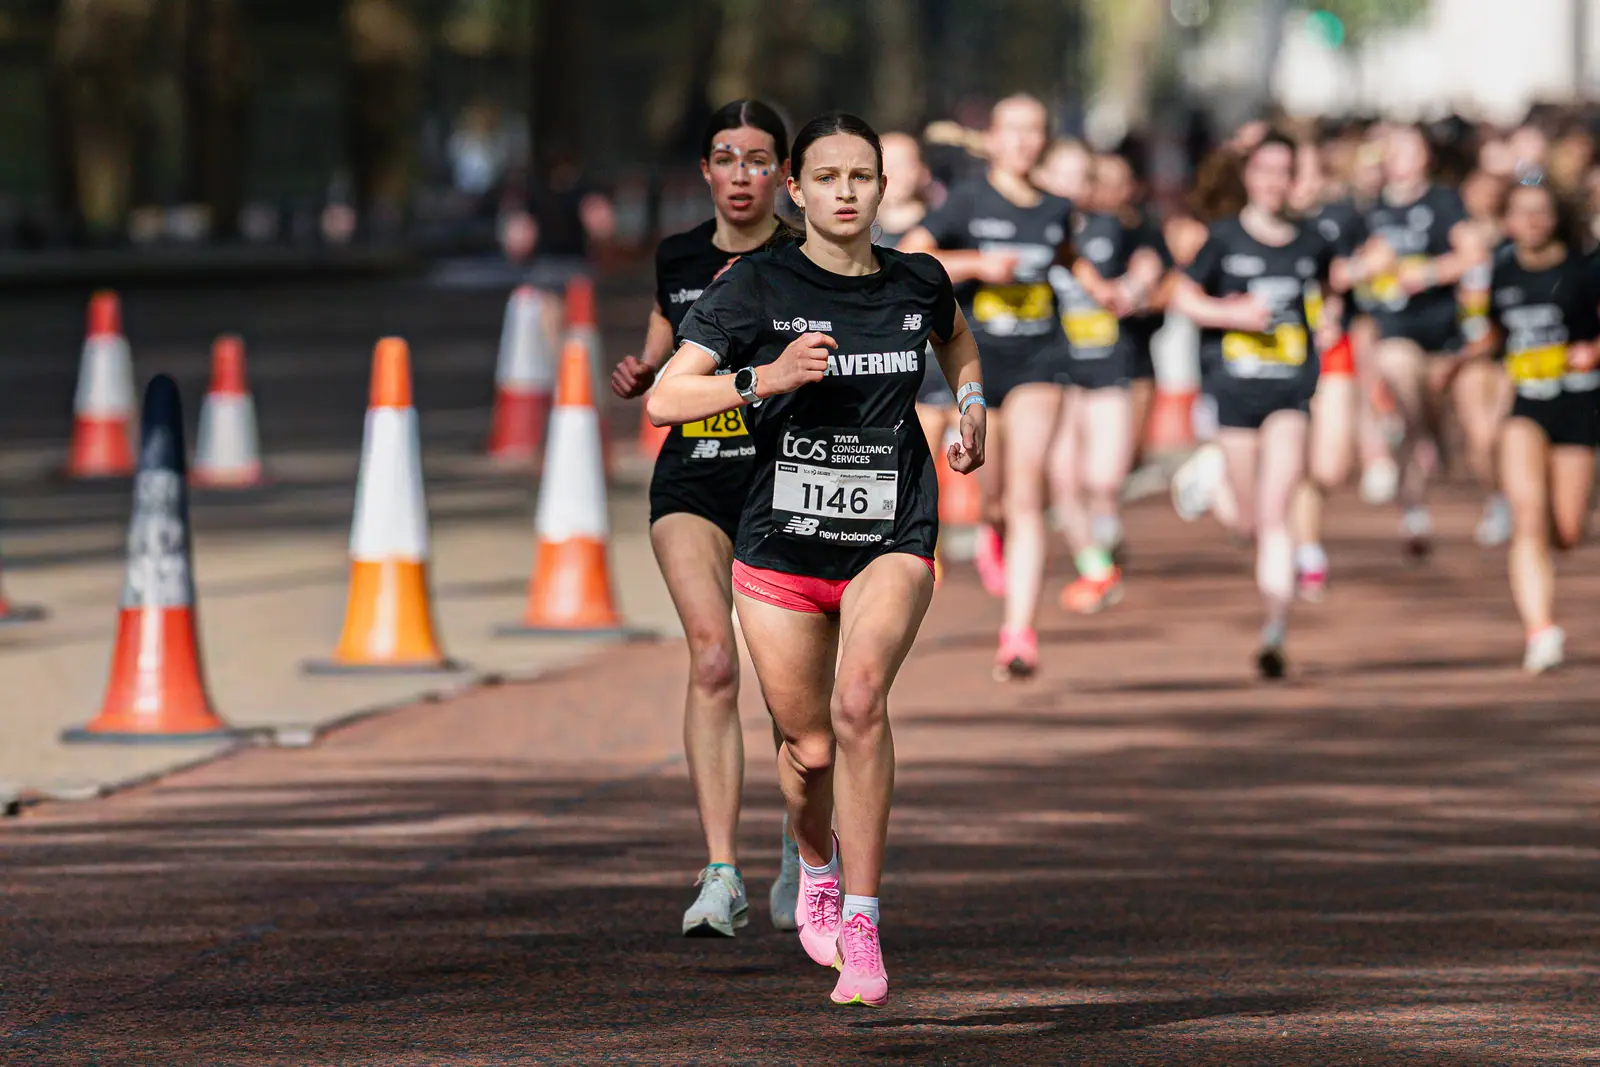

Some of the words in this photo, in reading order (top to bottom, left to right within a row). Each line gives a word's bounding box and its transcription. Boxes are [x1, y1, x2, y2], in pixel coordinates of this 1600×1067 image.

[773, 319, 791, 331] tcs
[824, 351, 918, 376] AVERING
[833, 435, 859, 443] TATA
[782, 431, 828, 461] tcs
[831, 445, 894, 455] CONSULTANCY
[831, 455, 870, 464] SERVICES
[802, 482, 868, 514] 1146
[819, 530, 839, 540] new
[840, 531, 882, 542] balance
